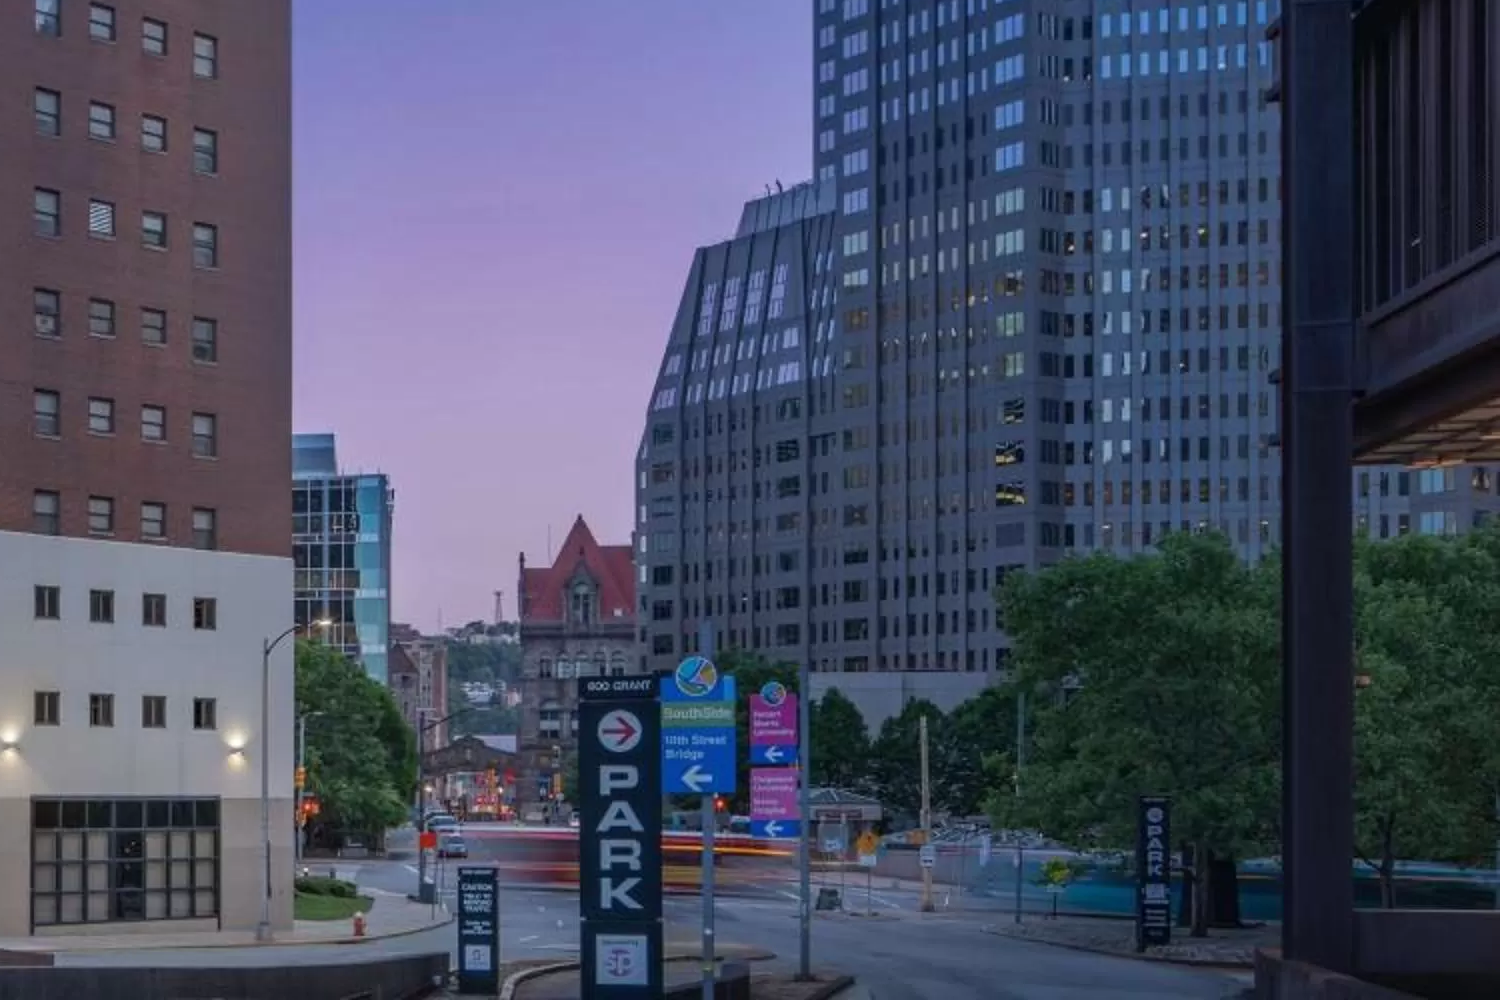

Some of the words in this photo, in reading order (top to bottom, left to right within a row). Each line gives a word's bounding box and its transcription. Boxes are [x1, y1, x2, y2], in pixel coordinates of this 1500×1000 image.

[613, 680, 651, 691] GRANT
[691, 735, 726, 745] Street
[665, 748, 705, 760] Bridge
[596, 764, 644, 909] PARK
[1147, 825, 1164, 876] PARK
